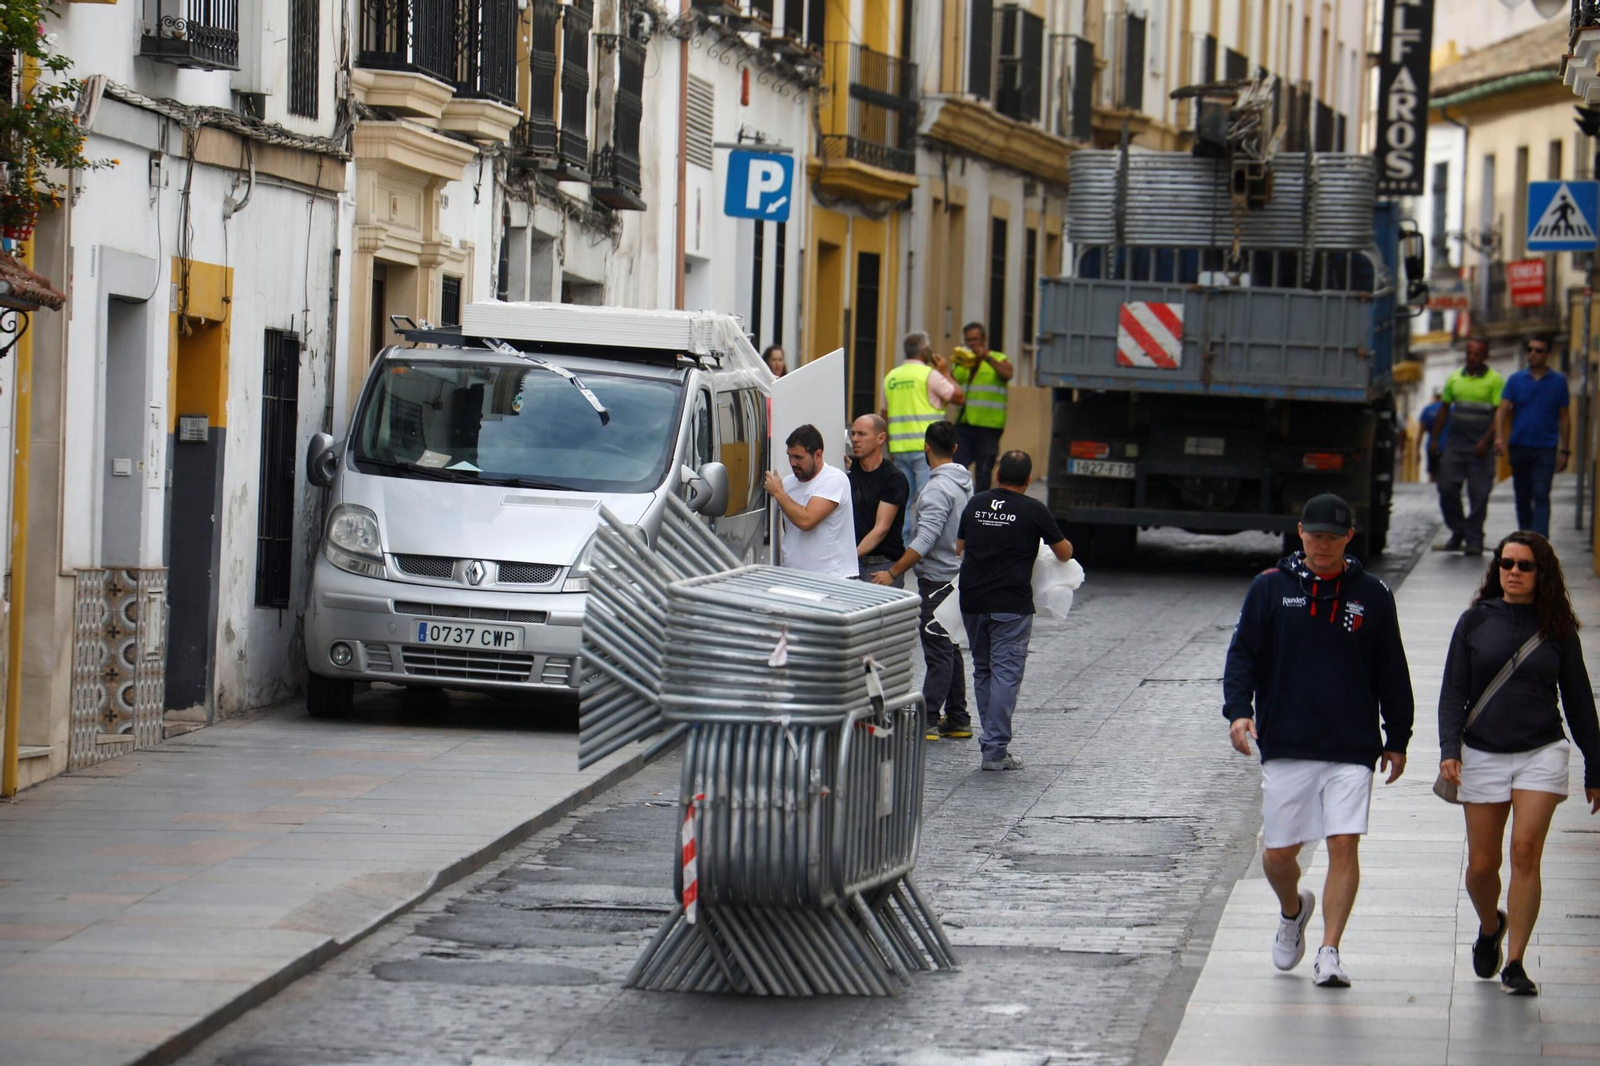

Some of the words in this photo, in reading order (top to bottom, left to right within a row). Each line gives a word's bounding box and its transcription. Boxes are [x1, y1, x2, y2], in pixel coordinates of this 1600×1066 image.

[1385, 0, 1421, 179] LFAROS
[745, 158, 785, 210] P
[430, 625, 475, 644] 0737
[481, 630, 515, 647] CWP
